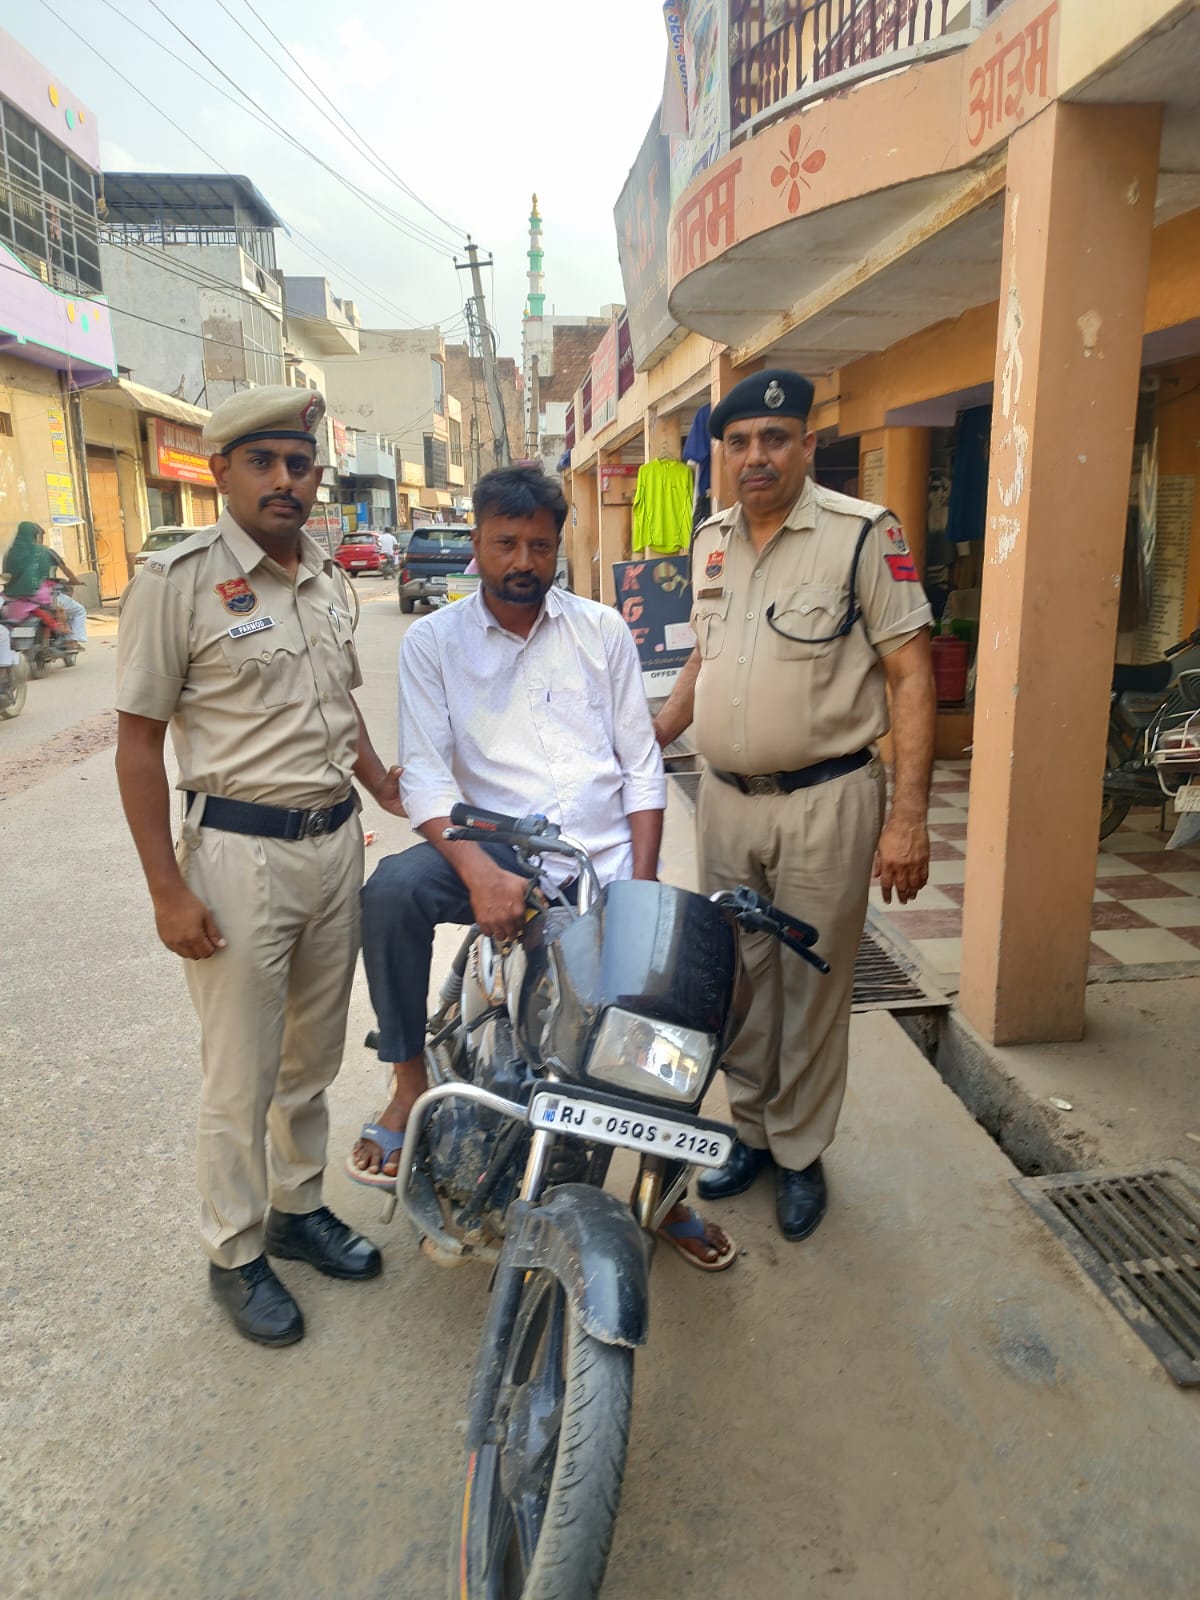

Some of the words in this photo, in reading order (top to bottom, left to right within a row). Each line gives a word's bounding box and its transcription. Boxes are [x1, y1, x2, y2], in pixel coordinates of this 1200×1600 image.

[238, 620, 265, 634] PARMOD
[650, 670, 677, 679] OFFER
[560, 1105, 586, 1126] RJ
[606, 1117, 657, 1143] 05QS
[674, 1132, 720, 1157] 2126
